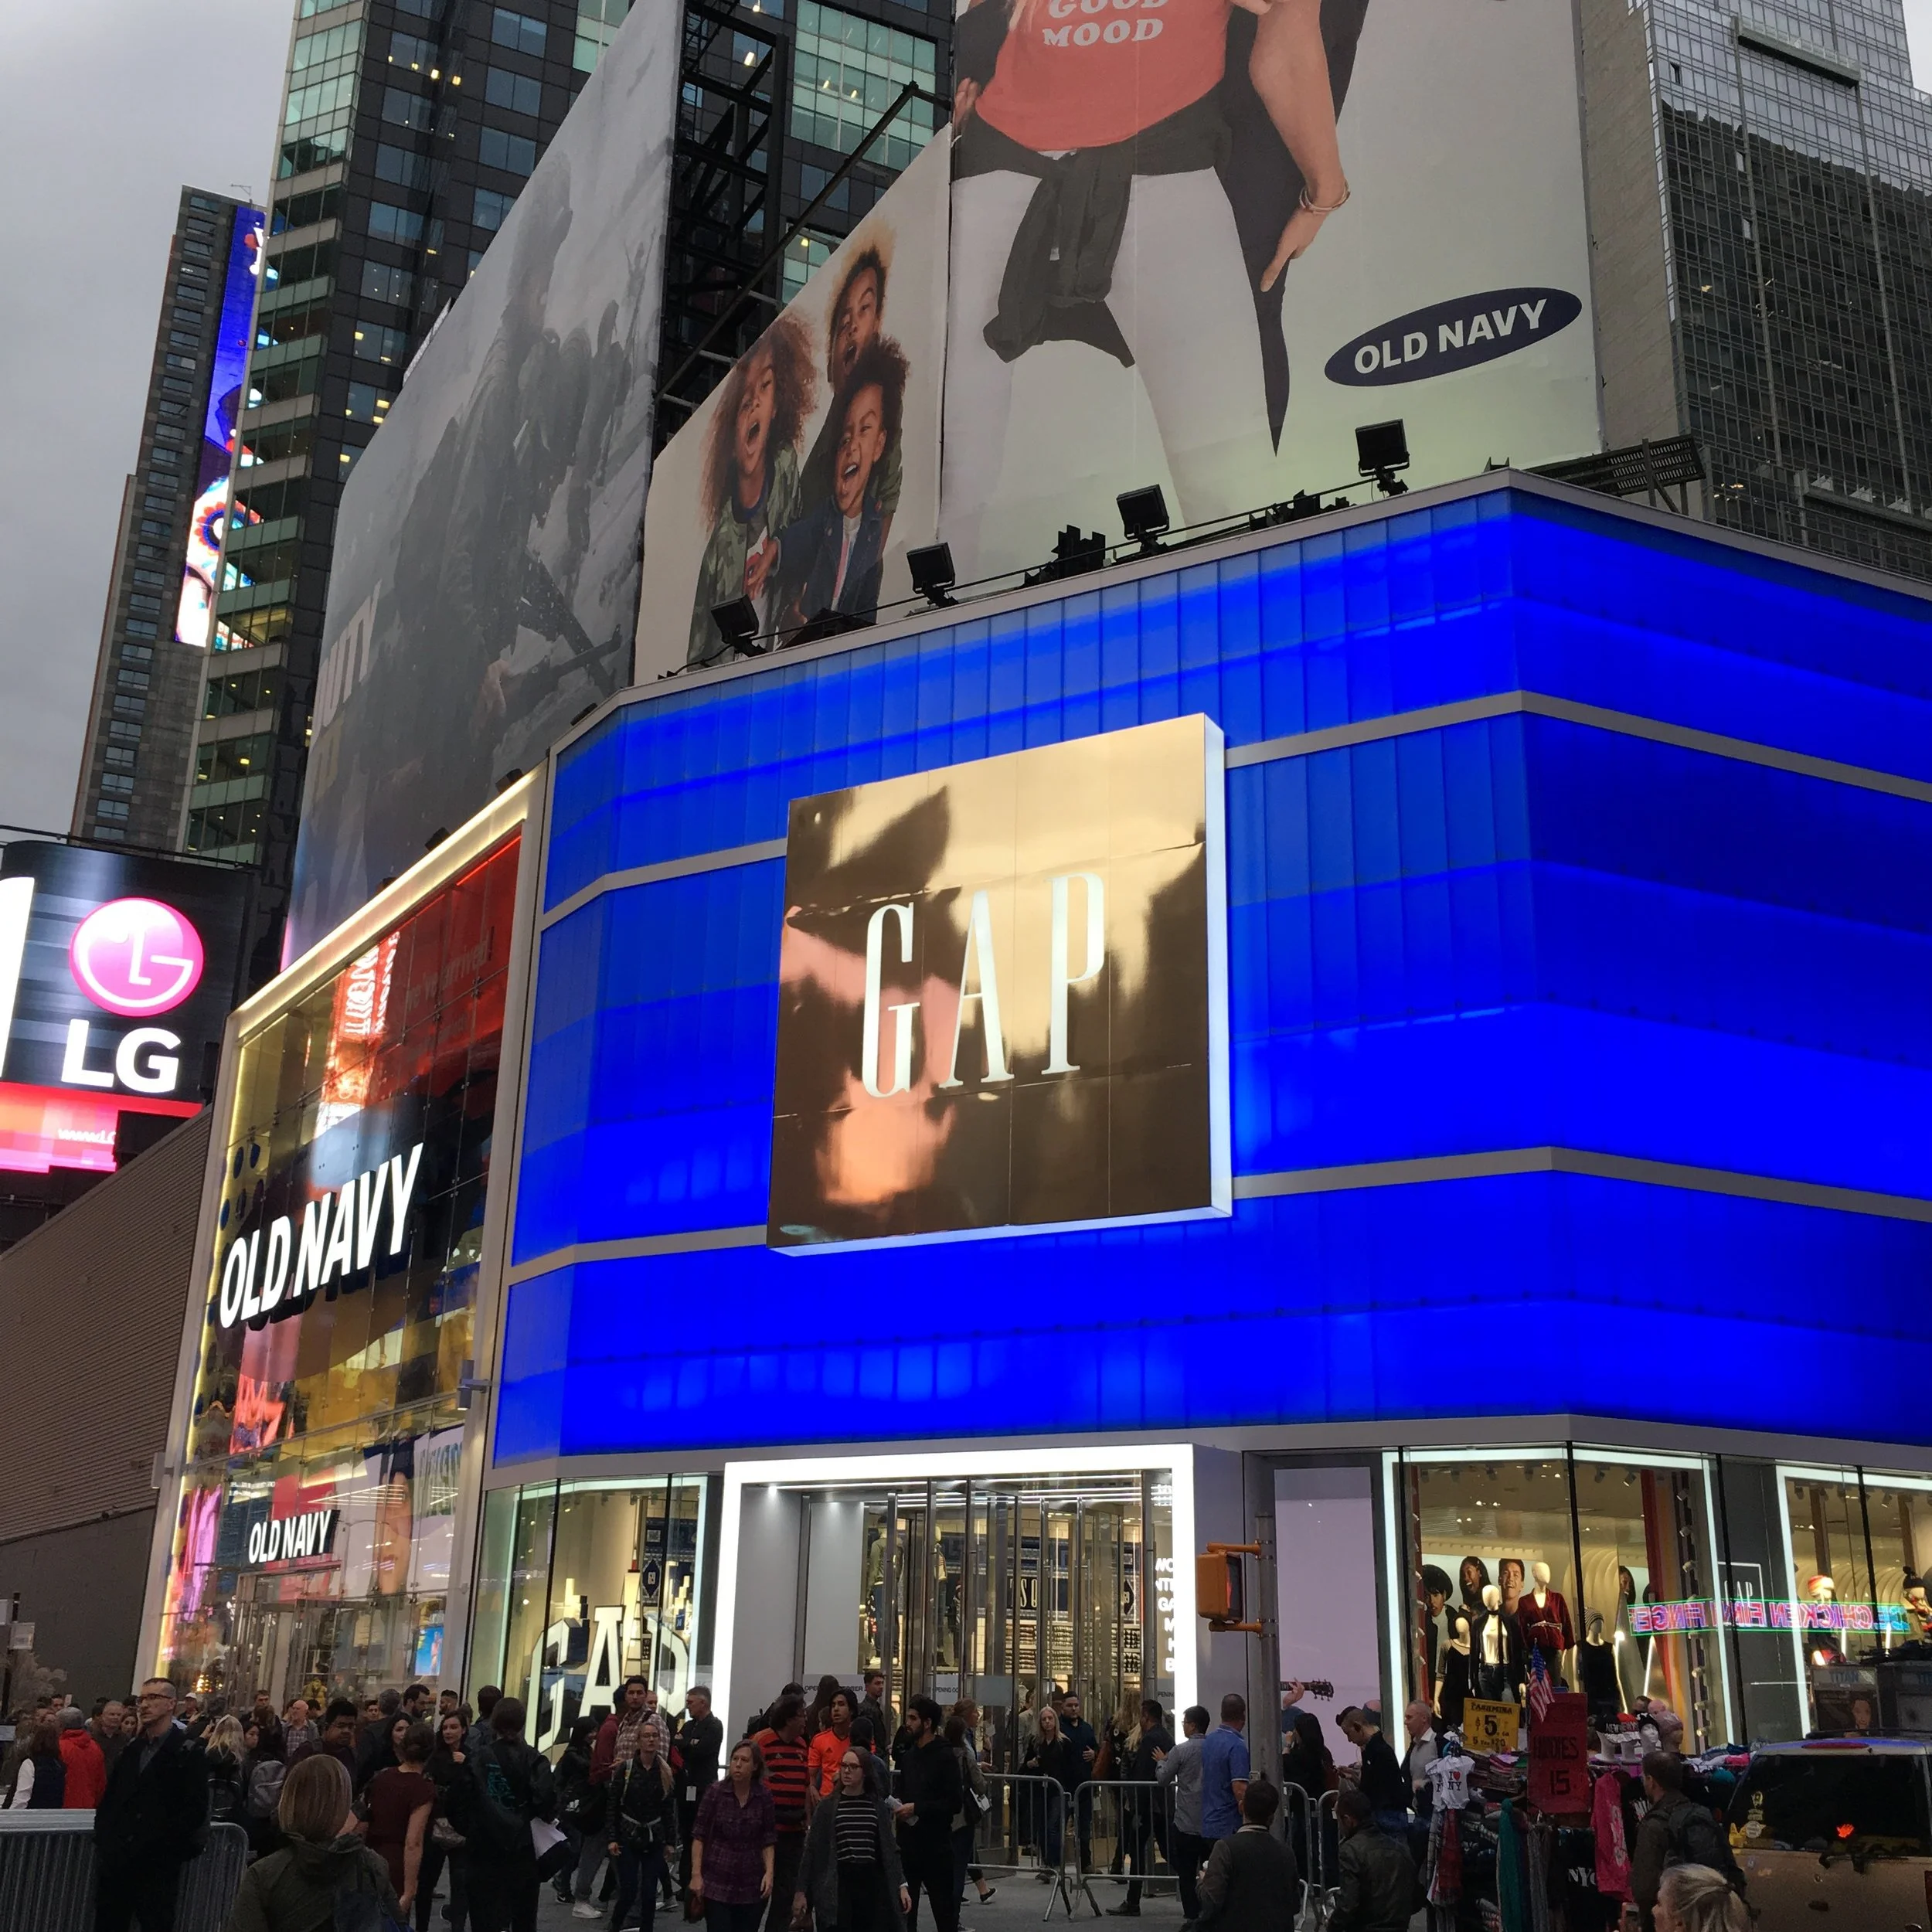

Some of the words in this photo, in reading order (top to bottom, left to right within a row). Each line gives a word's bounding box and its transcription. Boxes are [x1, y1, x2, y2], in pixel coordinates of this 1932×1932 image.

[1042, 18, 1164, 47] MOOD
[1354, 331, 1428, 374] OLD
[1438, 298, 1547, 353] NAVY
[861, 871, 1104, 1098] GAP
[61, 1018, 182, 1094] LG
[219, 1216, 291, 1328] OLD
[293, 1142, 423, 1298] NAVY
[249, 1519, 281, 1563] OLD
[281, 1509, 332, 1559] NAVY
[525, 1605, 689, 1753] GAP
[1447, 1781, 1462, 1791] NY
[1550, 1770, 1571, 1795] 15
